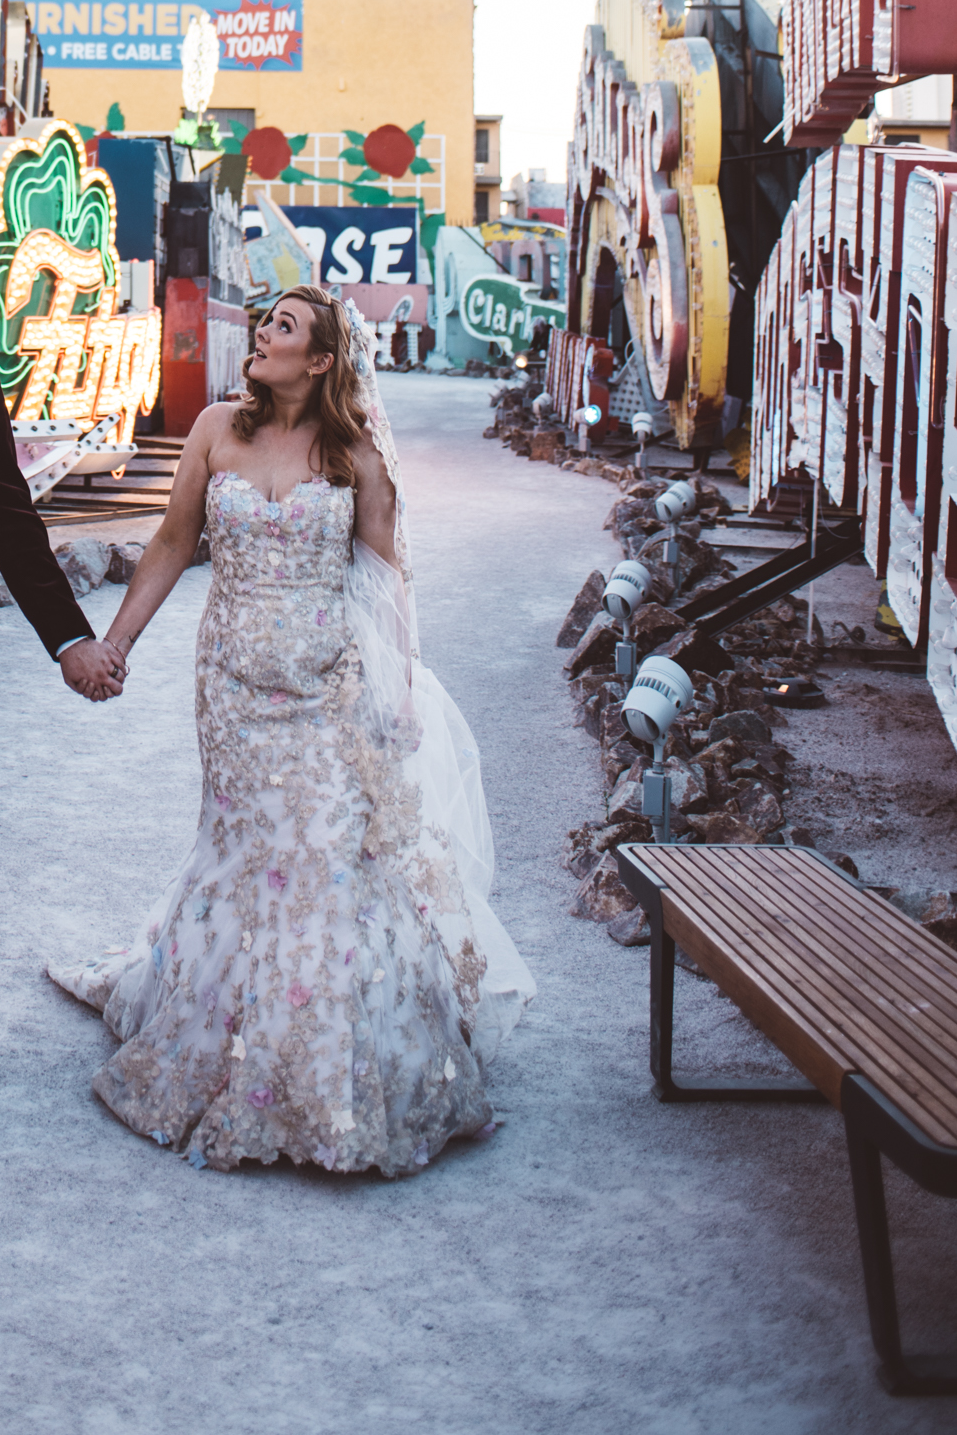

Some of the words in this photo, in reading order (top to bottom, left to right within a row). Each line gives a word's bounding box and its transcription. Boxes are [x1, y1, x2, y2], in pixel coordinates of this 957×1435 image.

[217, 11, 270, 35] MOVE
[273, 9, 296, 33] IN
[61, 42, 107, 60] FREE
[112, 43, 172, 61] CABLE
[226, 33, 289, 59] TODAY
